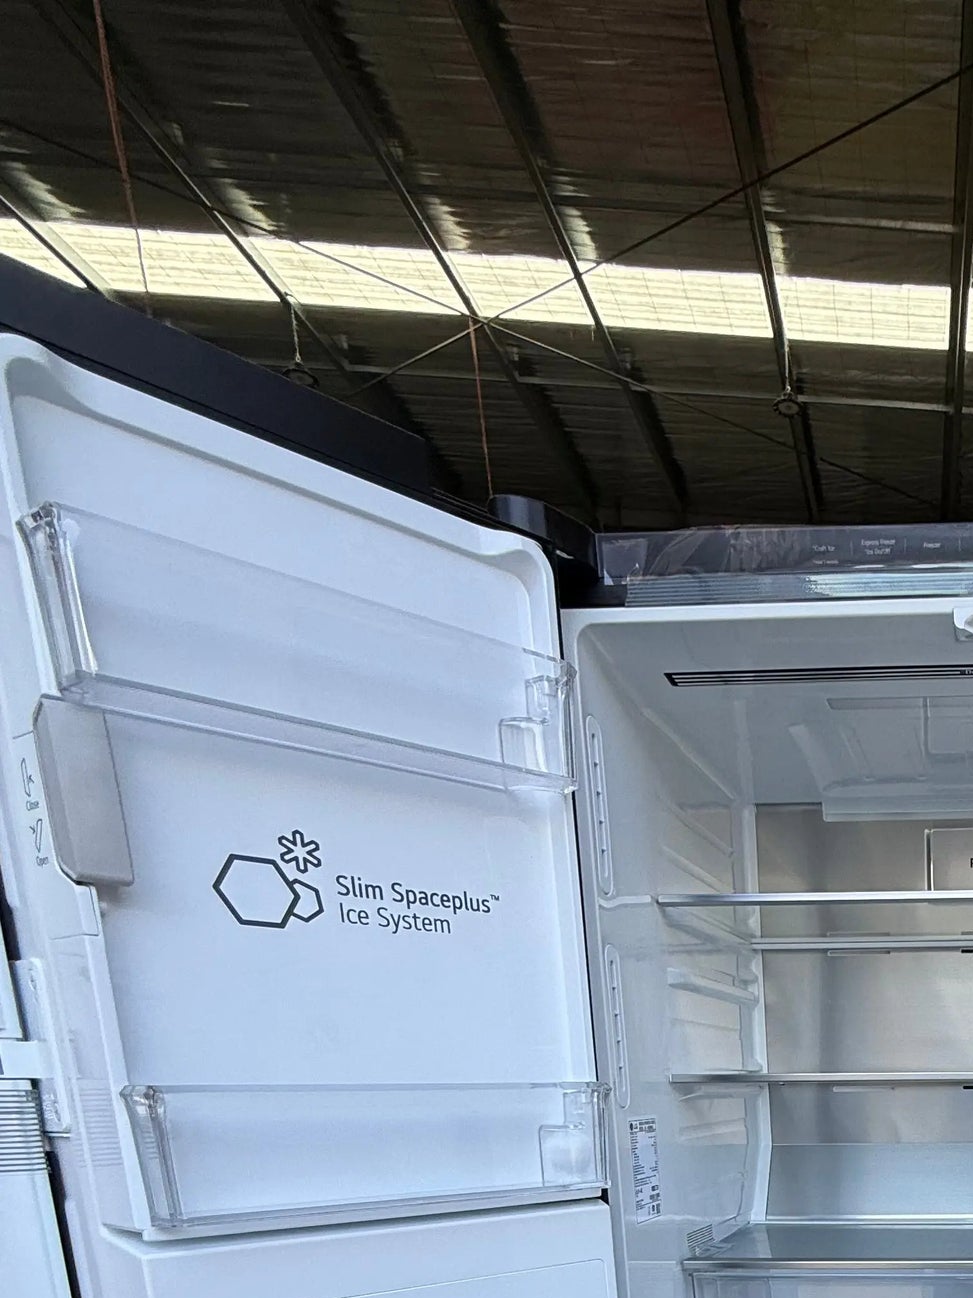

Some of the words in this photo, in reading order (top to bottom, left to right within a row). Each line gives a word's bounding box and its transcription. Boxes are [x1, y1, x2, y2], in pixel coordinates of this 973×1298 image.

[335, 874, 384, 900] Slim
[339, 902, 370, 926] Ice
[376, 906, 451, 934] System
